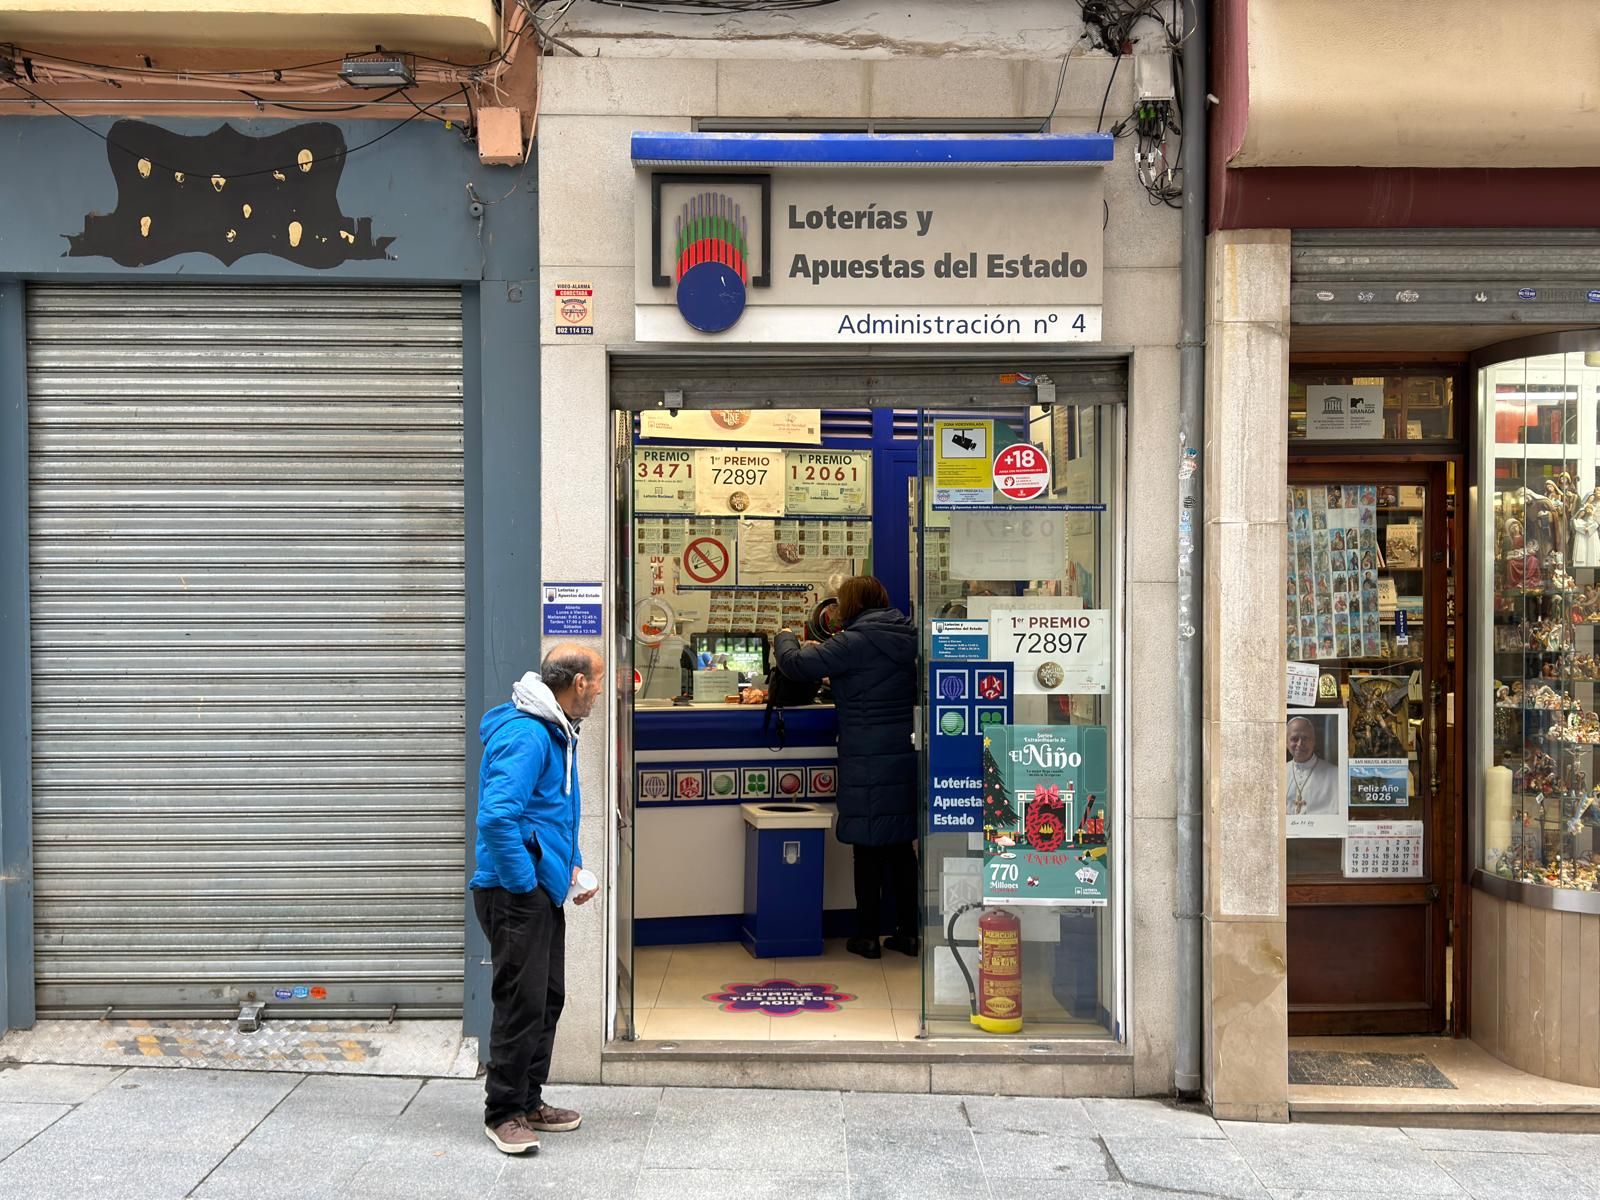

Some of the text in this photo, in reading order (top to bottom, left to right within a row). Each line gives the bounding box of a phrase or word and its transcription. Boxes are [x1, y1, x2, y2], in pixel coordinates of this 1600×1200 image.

[788, 204, 933, 236] Loterías y
[788, 252, 1088, 285] Apuestas del Estado
[838, 314, 1086, 334] Administración nº 4
[644, 451, 690, 462] PREMIO
[724, 456, 770, 466] PREMIO
[808, 455, 852, 465] PREMIO
[1004, 450, 1035, 468] +18
[638, 462, 692, 478] 3471
[711, 468, 768, 485] 72897
[791, 465, 857, 481] 12061
[1011, 617, 1090, 628] 1er PREMIO
[1013, 633, 1087, 653] 72897
[1008, 744, 1082, 769] El Niño
[934, 776, 982, 789] Loterías
[933, 795, 984, 810] Apuesta
[1365, 793, 1391, 801] 2026
[934, 813, 975, 825] Estado
[990, 864, 1019, 881] 770
[990, 881, 1019, 889] Millones
